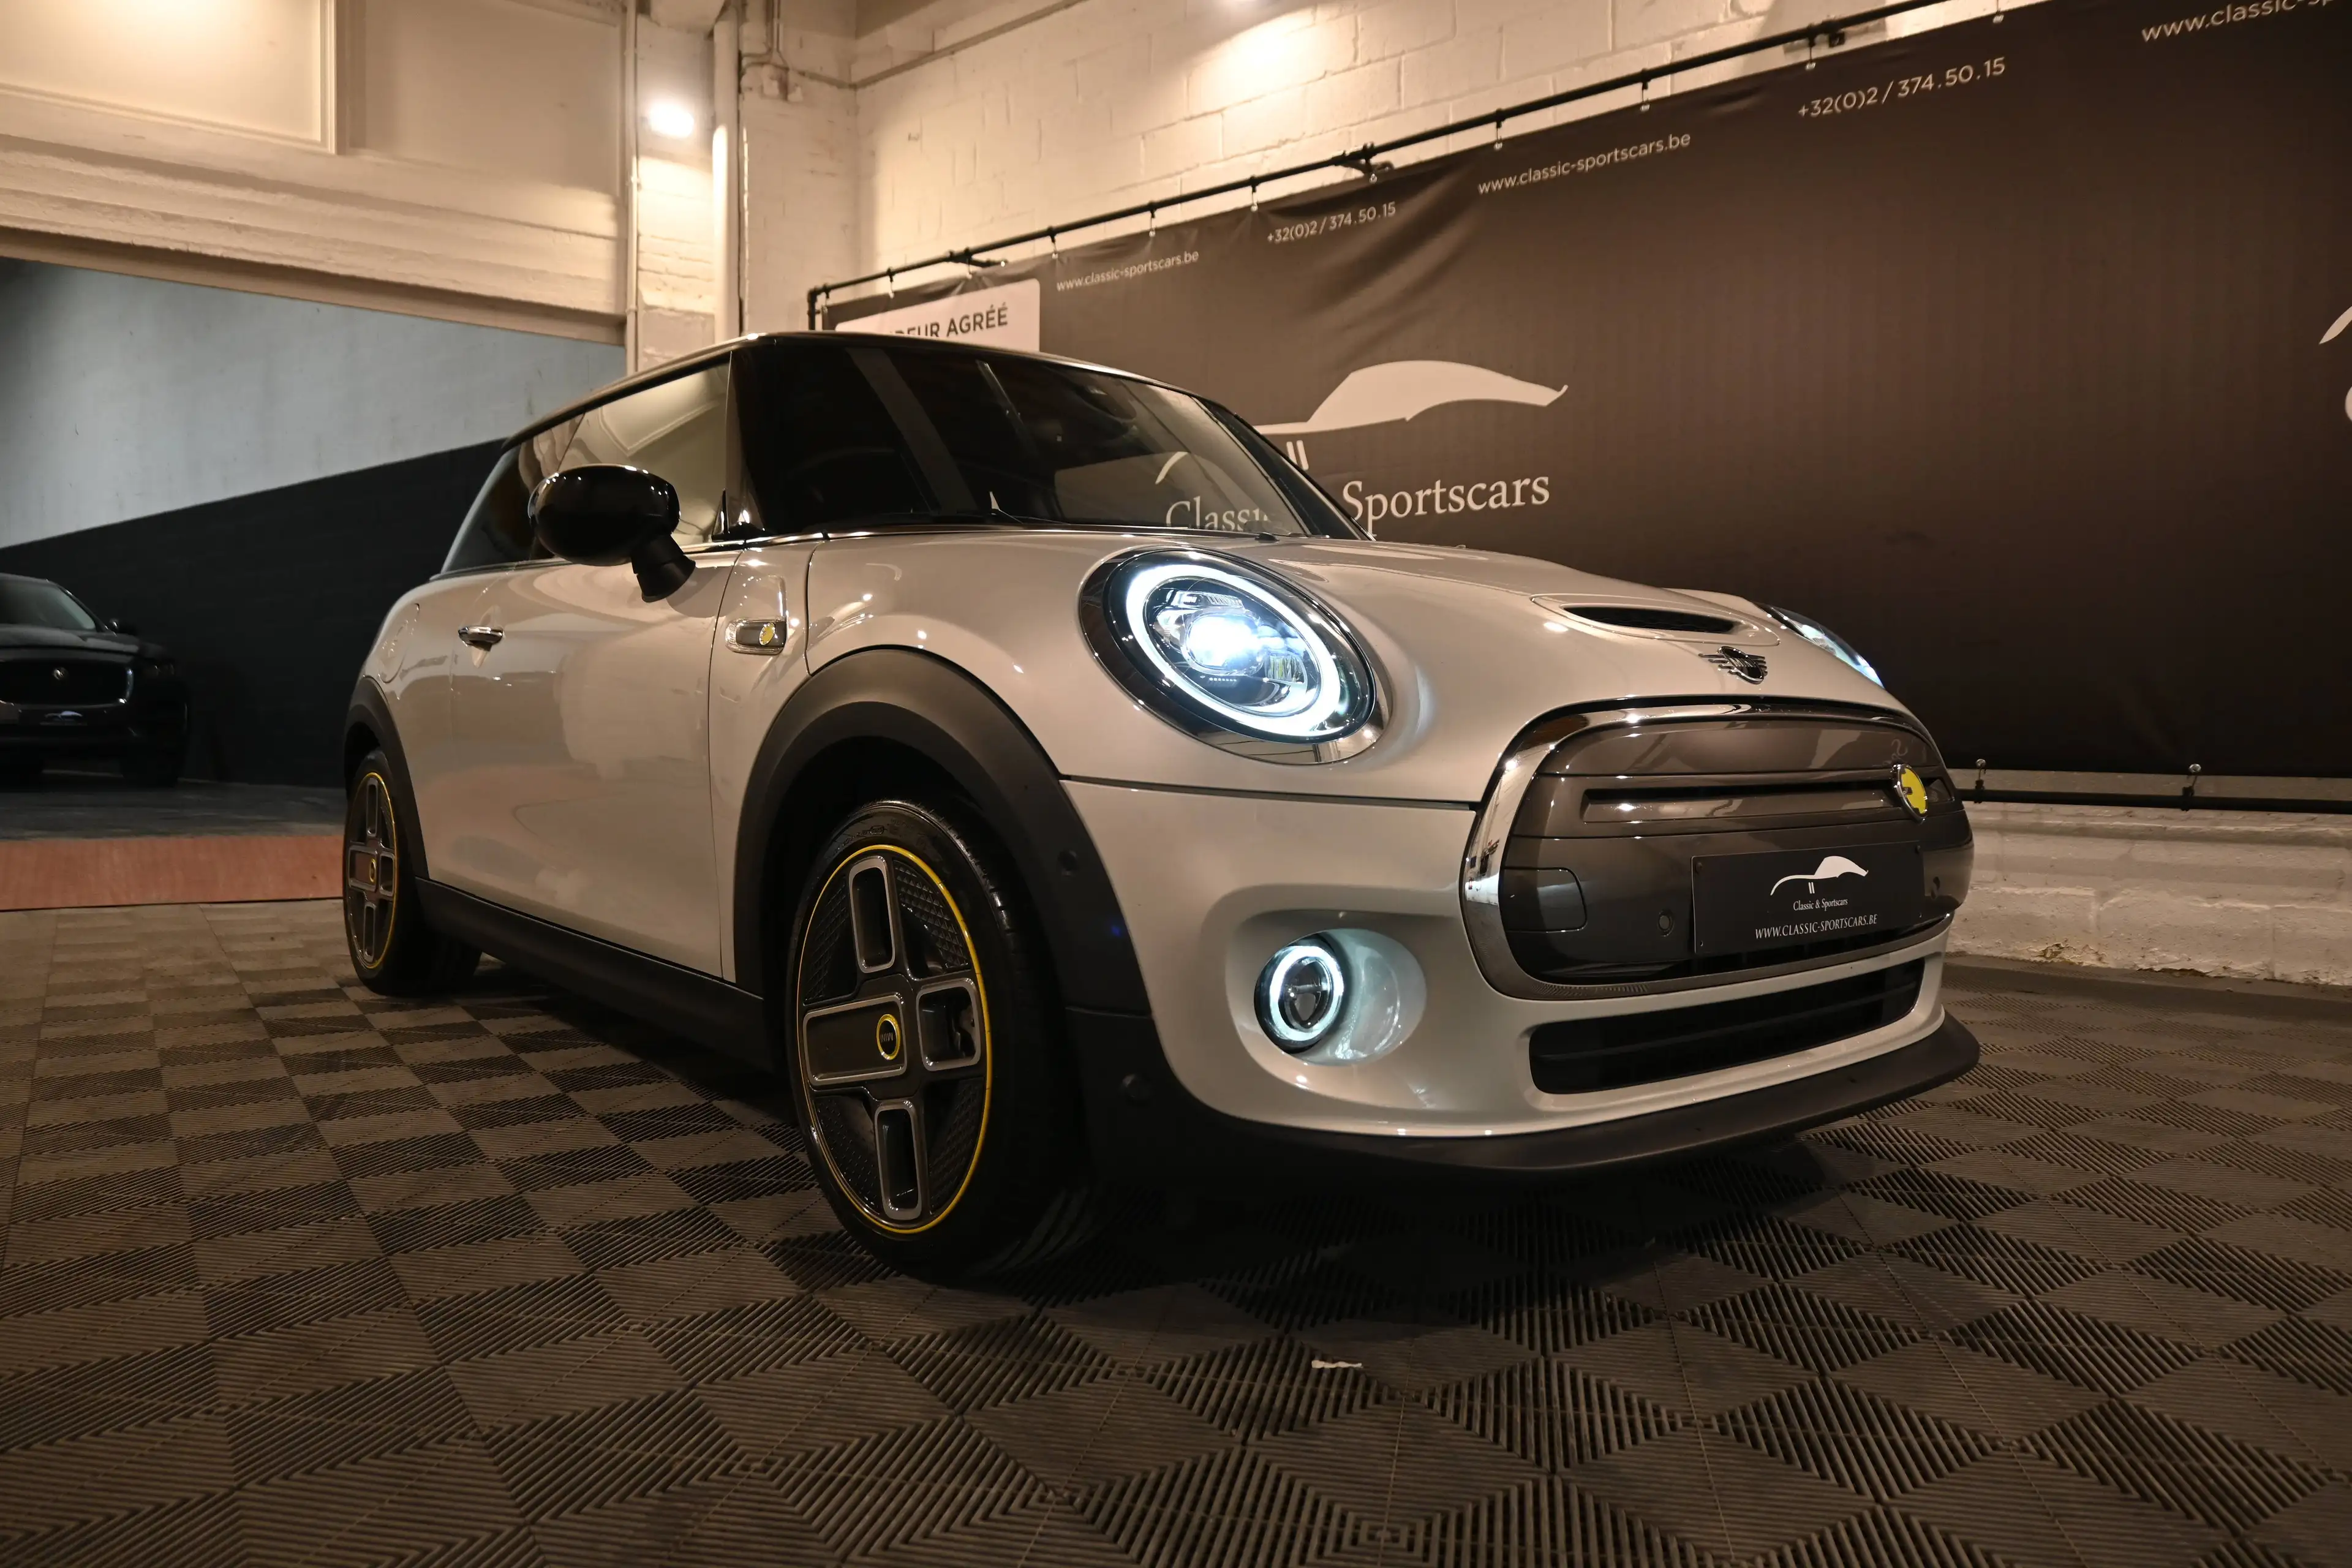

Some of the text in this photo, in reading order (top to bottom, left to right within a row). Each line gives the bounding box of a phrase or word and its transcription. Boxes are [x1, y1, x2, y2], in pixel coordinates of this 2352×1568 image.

[1478, 133, 1691, 195] www.classic-sportscars.be
[1056, 250, 1199, 292] www.classic-sportscars.be
[946, 302, 1009, 337] AGRÉÉ
[1342, 476, 1551, 537] Sportscars
[1793, 898, 1849, 911] Classic & Sportscars
[1755, 914, 1879, 939] WWW.CLASSIC-SPORTSCARS.BE
